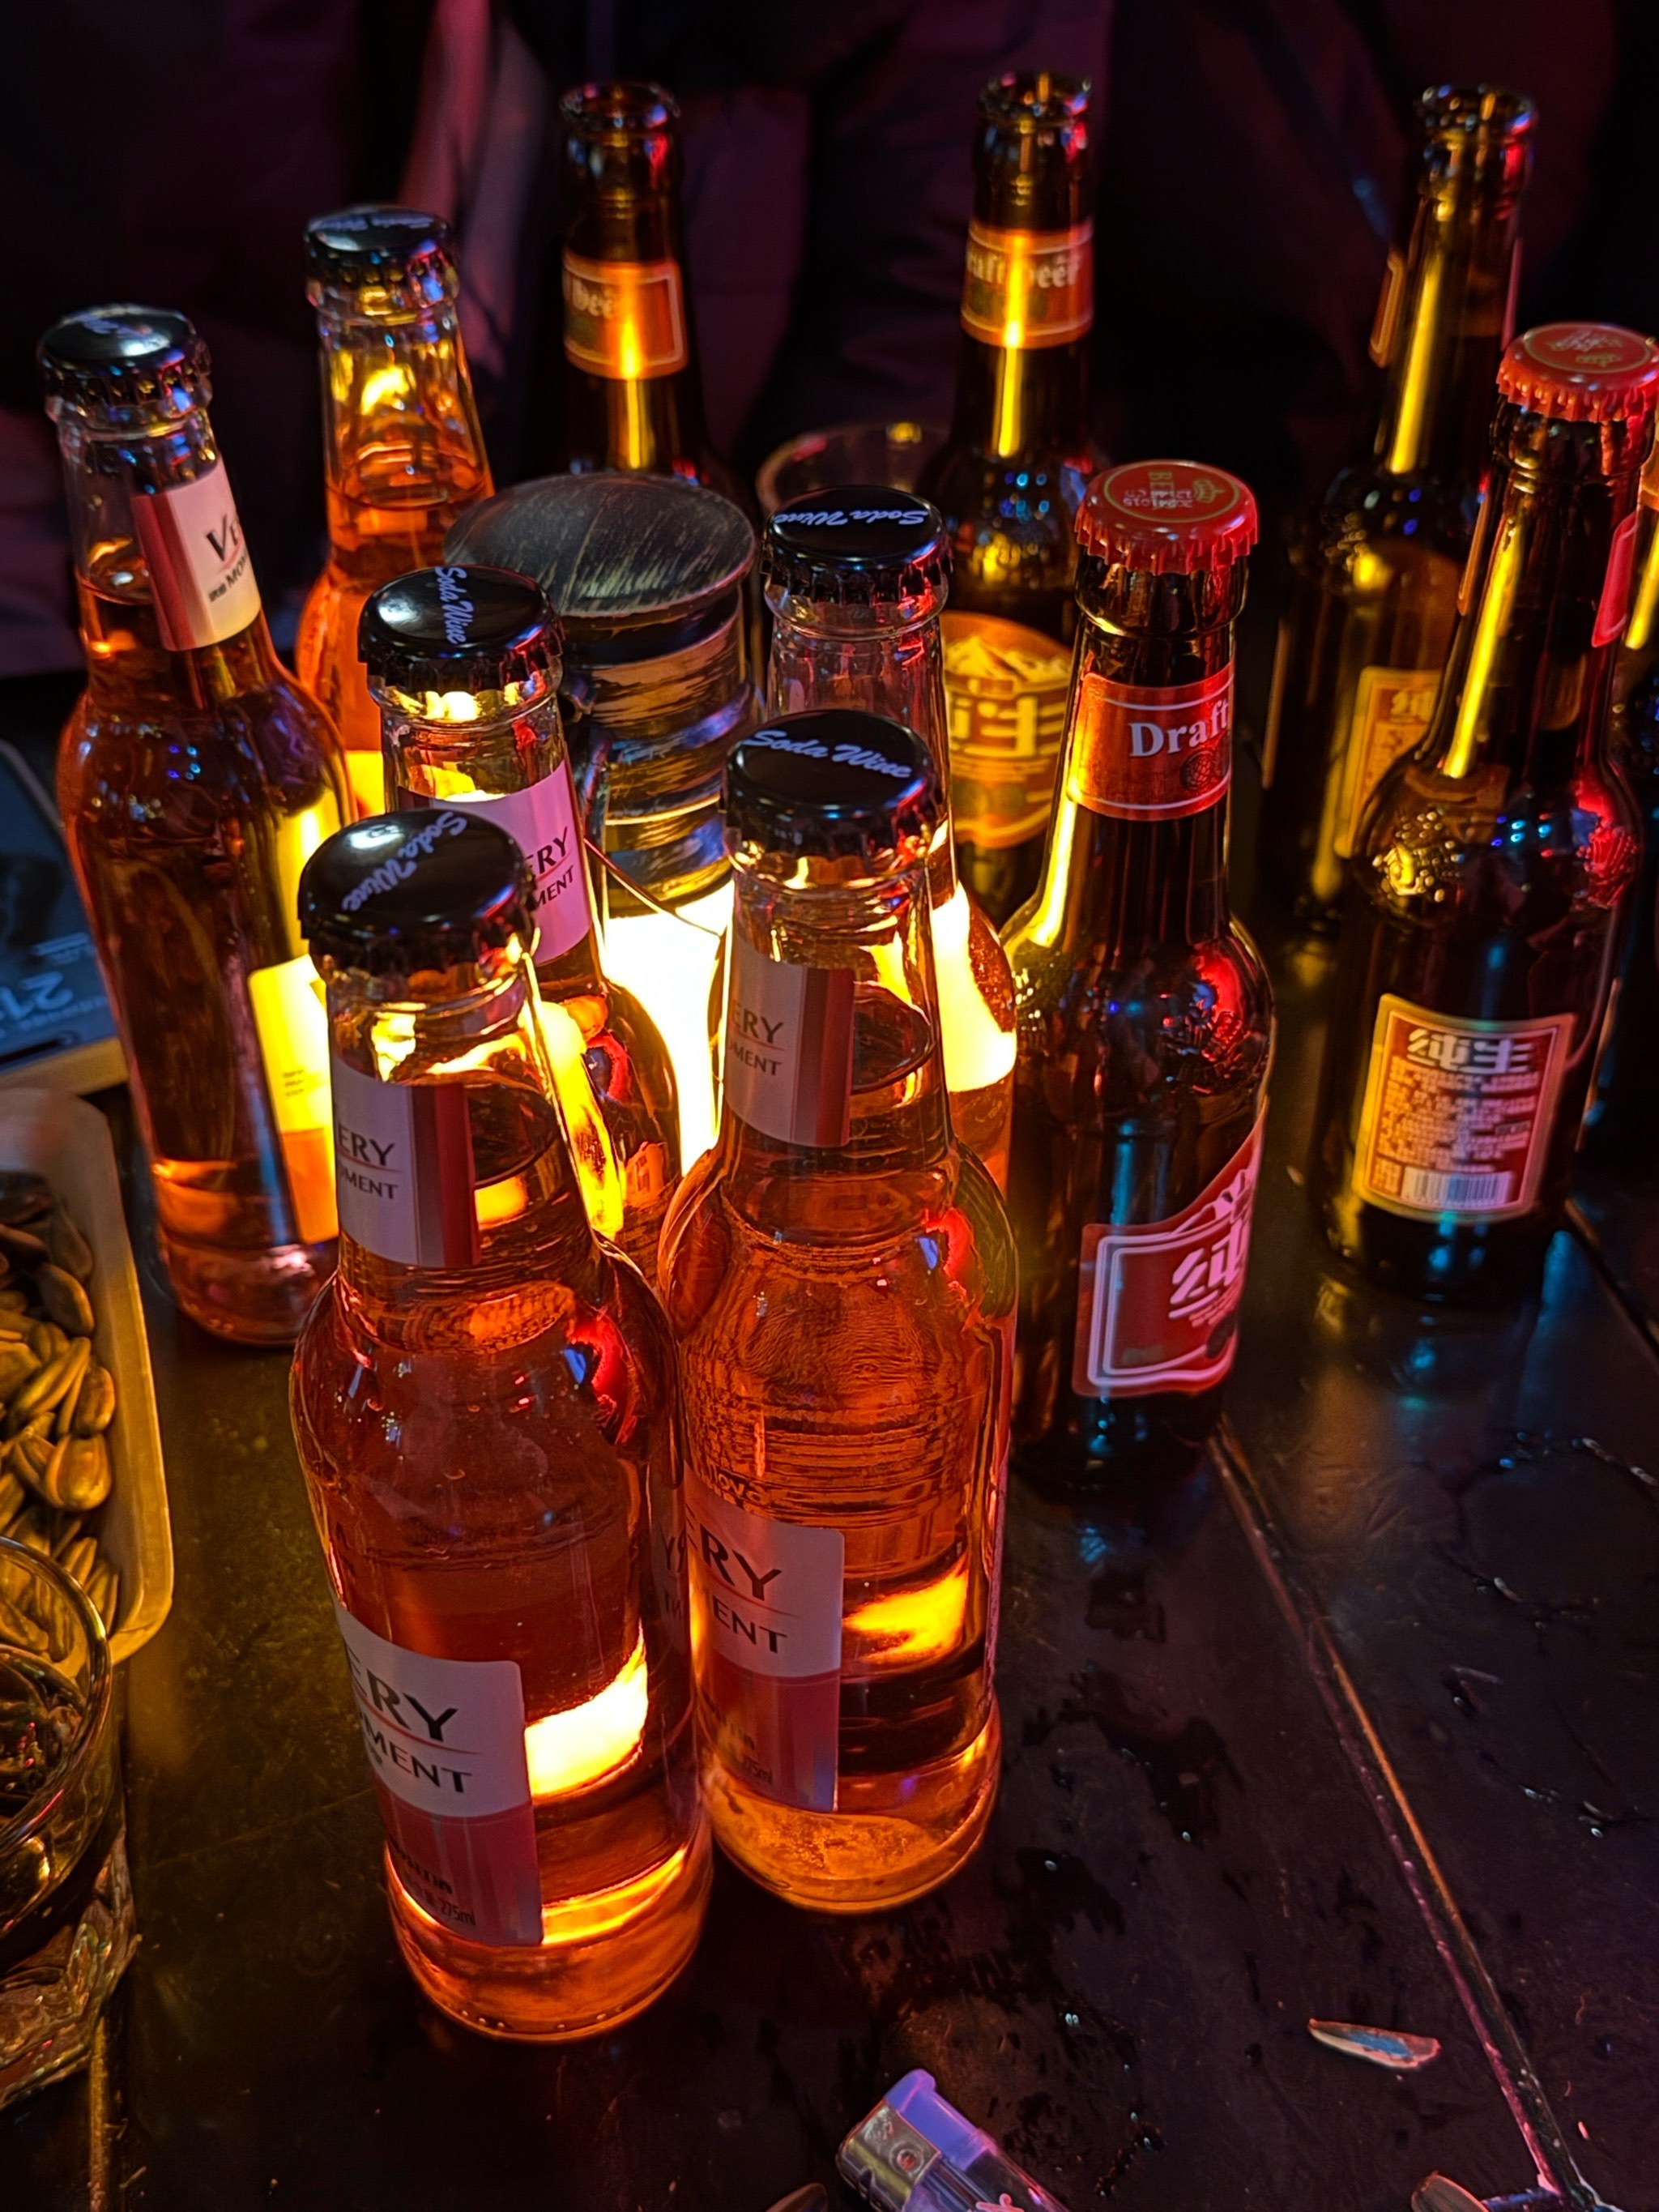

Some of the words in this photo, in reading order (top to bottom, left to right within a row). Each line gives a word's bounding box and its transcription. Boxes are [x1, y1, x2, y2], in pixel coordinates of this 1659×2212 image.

[774, 510, 848, 526] Wine
[851, 510, 929, 525] Soda
[434, 566, 467, 602] Soda
[443, 600, 474, 644] Wine
[1128, 698, 1229, 757] Draft
[743, 730, 829, 758] Soda
[832, 745, 912, 778] Wine
[399, 811, 467, 858] Soda
[342, 857, 418, 911] Wine
[1405, 1027, 1533, 1074] 纯生
[338, 1121, 396, 1167] ERY
